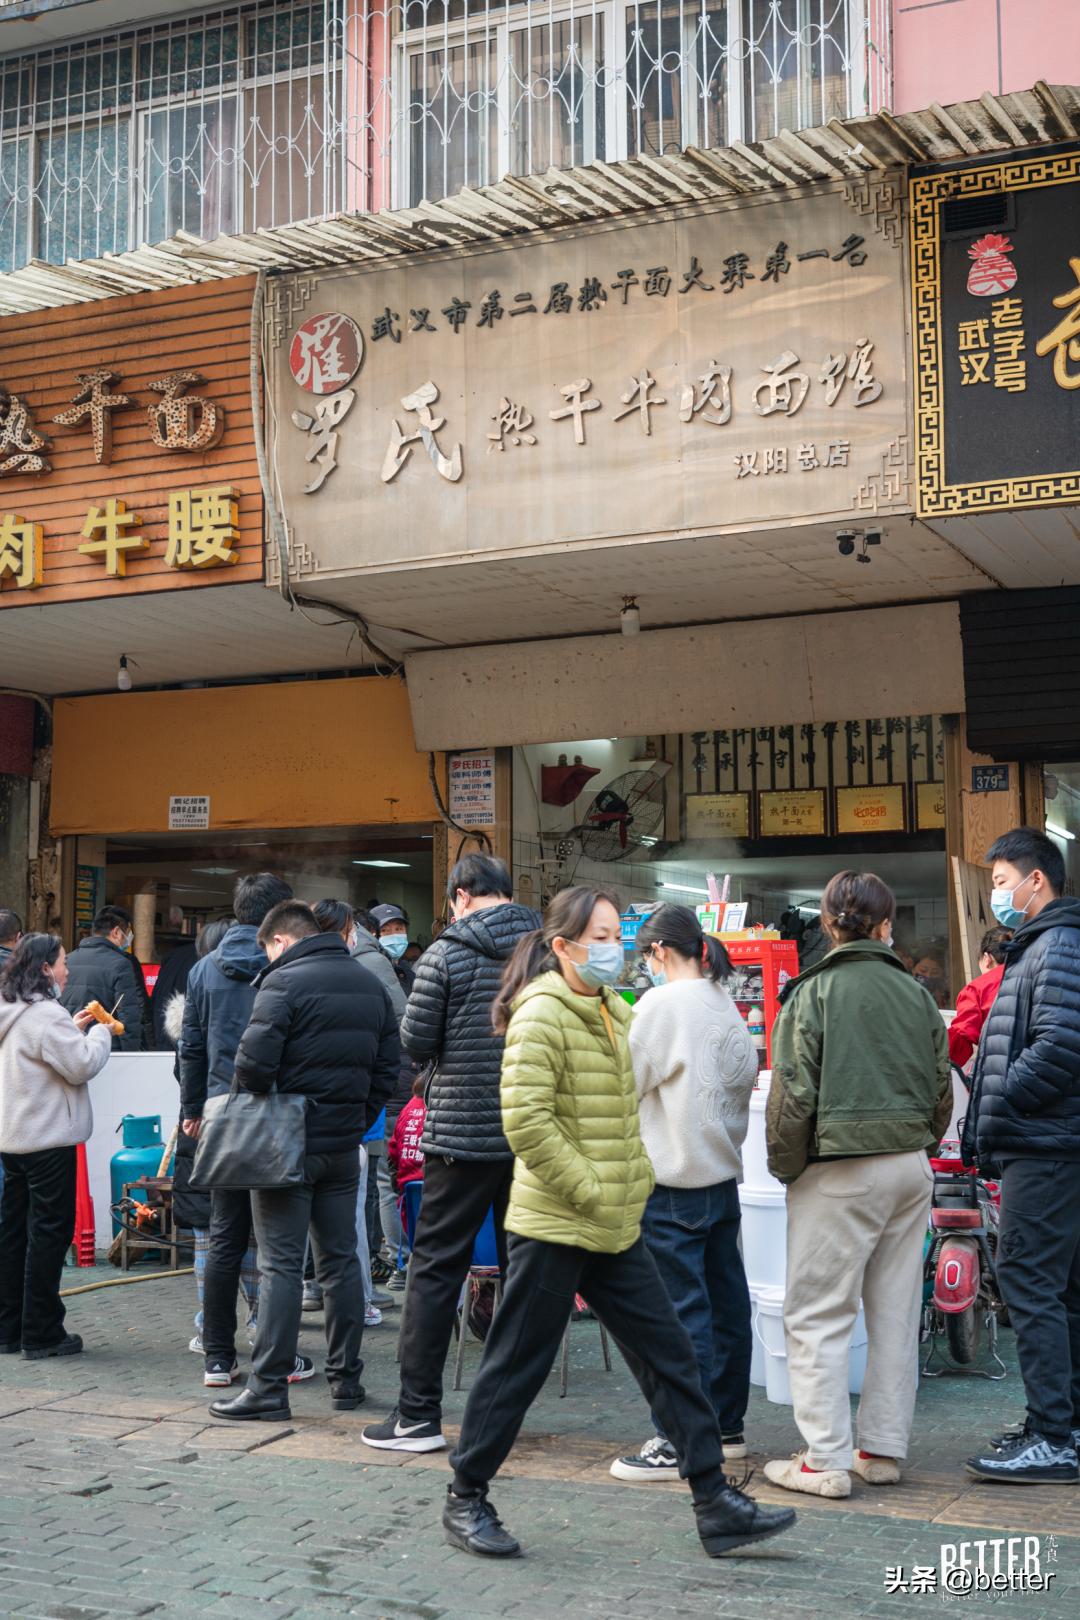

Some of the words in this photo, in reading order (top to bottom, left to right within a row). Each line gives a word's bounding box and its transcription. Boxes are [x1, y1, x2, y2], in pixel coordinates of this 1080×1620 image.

[958, 318, 990, 386] 武汉
[991, 297, 1027, 392] 老字号
[733, 440, 851, 479] 汉阳总店
[976, 775, 998, 789] 379
